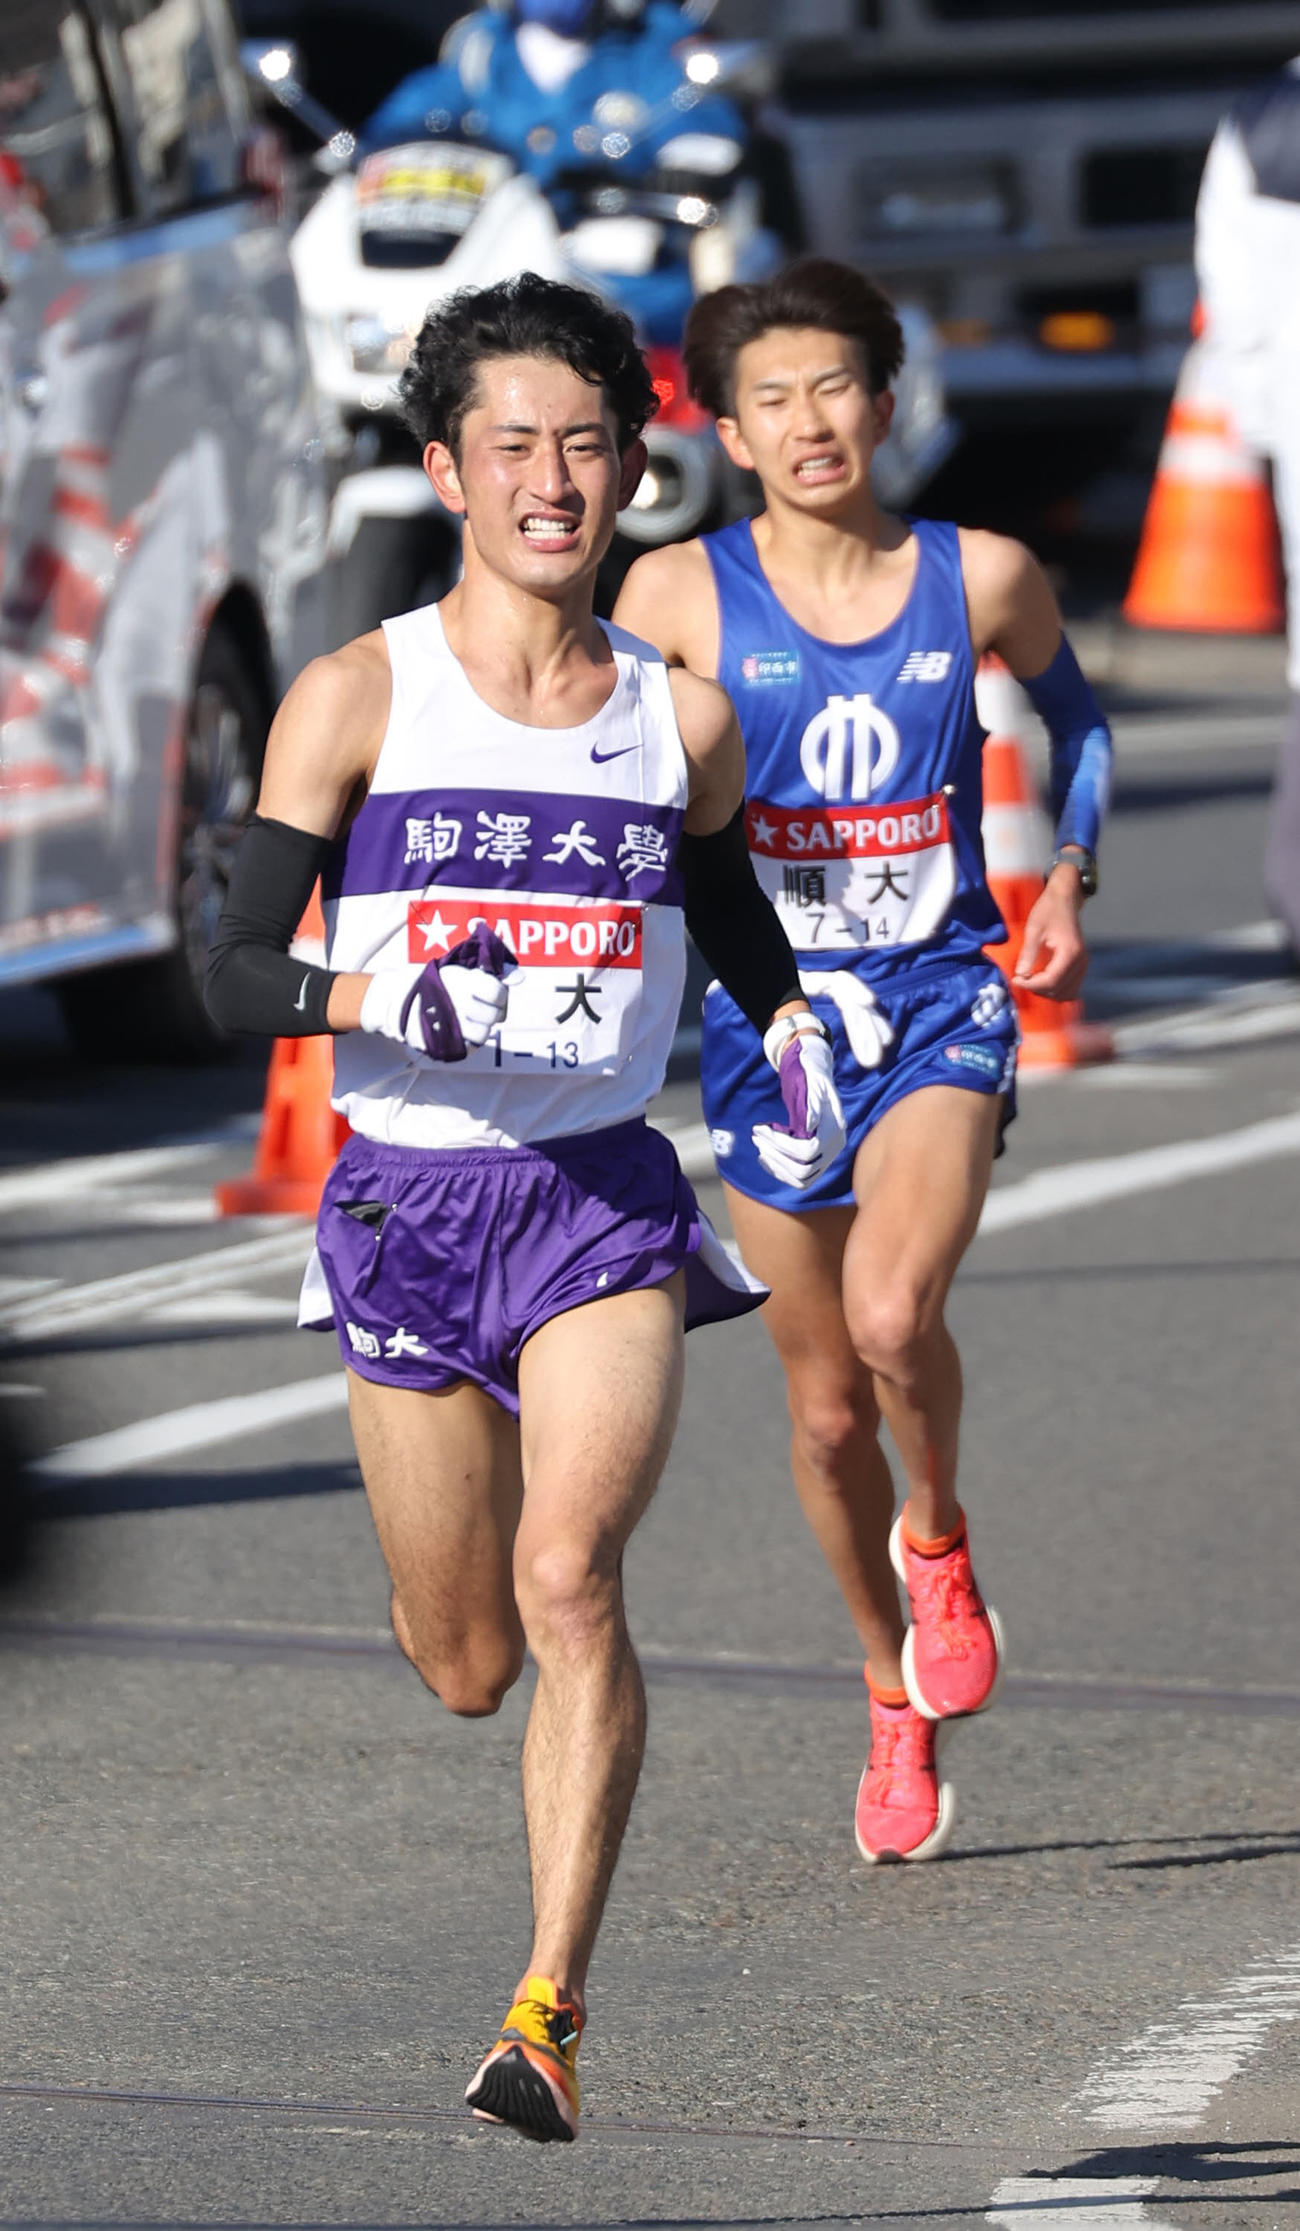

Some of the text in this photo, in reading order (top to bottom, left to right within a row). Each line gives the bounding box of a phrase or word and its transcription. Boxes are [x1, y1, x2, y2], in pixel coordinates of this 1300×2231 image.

[404, 811, 668, 881] 駒澤大學
[786, 804, 940, 850] SAPPORO
[783, 861, 909, 908] 順大
[805, 912, 890, 944] 7-14
[555, 973, 603, 1025] 大
[488, 1030, 579, 1068] 1-13
[346, 1321, 428, 1358] 駒大
